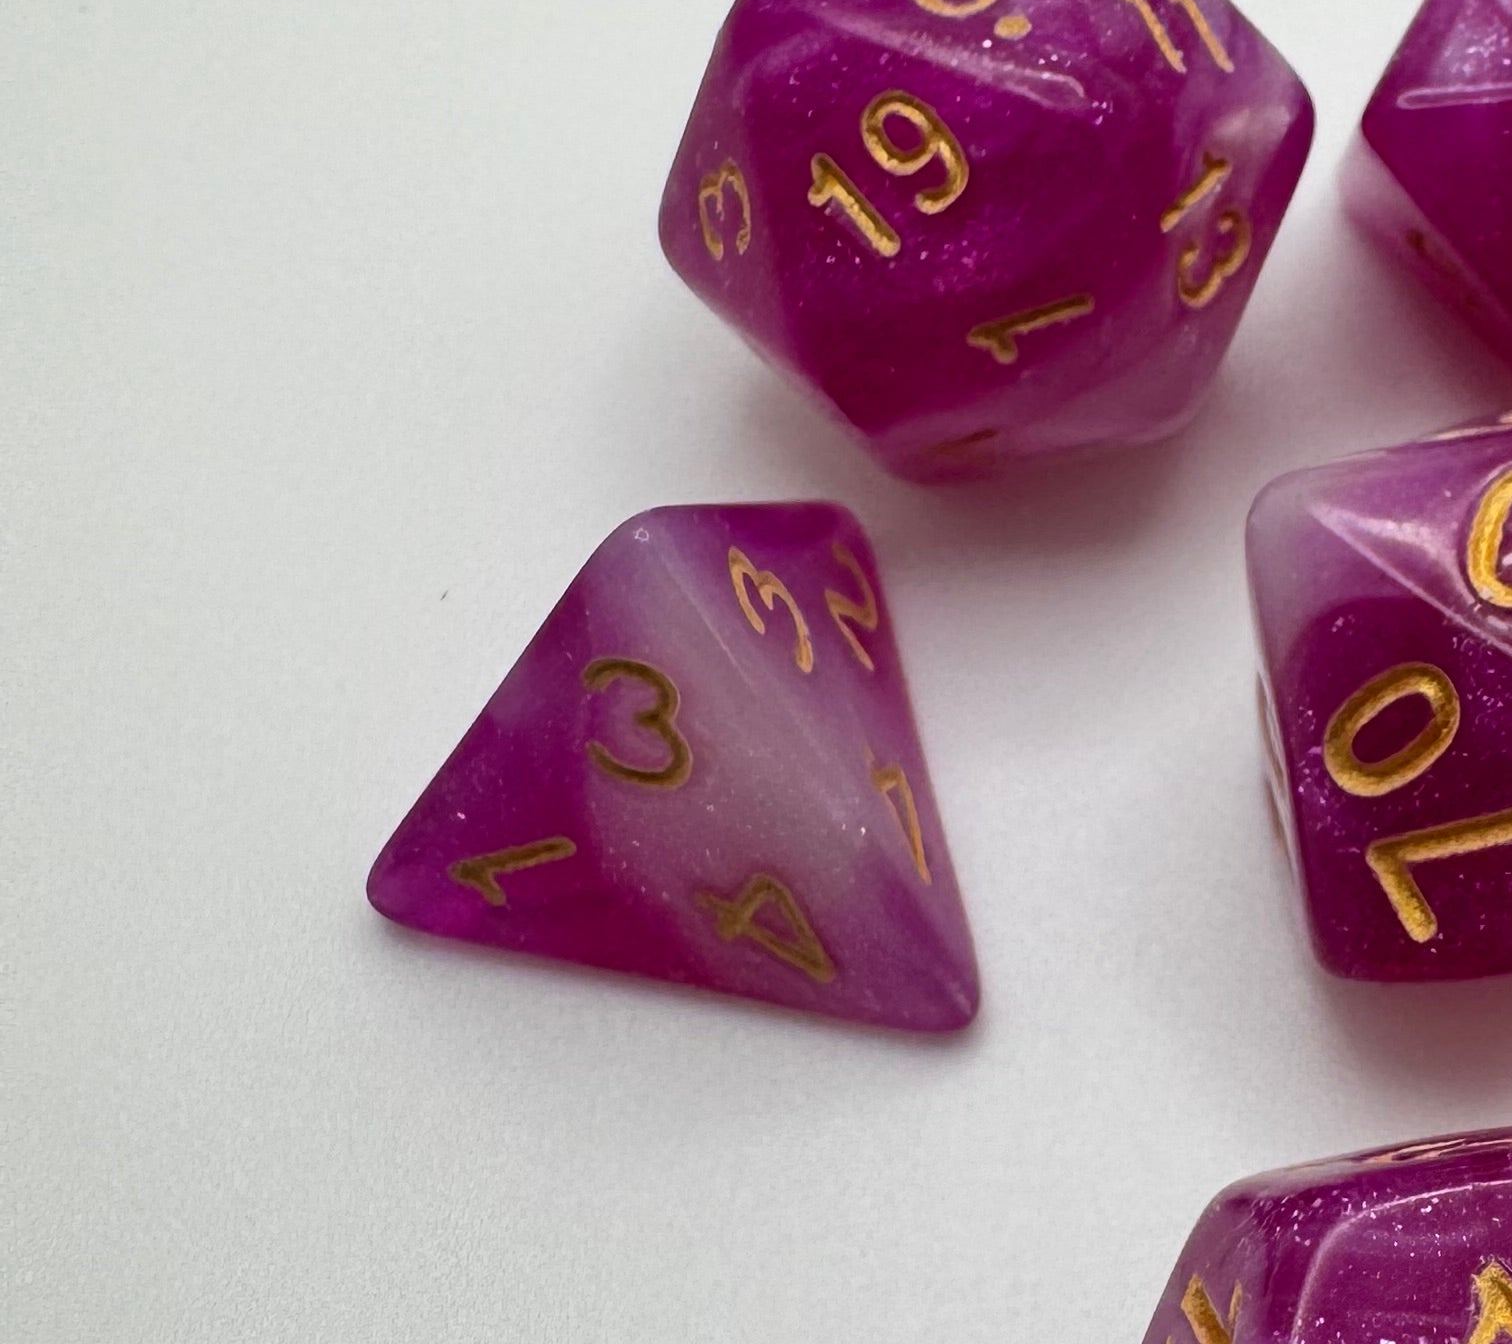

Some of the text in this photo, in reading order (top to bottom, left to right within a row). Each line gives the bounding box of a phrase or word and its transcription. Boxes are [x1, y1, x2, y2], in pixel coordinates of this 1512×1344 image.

[808, 89, 970, 259] 19
[1159, 152, 1252, 309] 13
[965, 294, 1096, 365] 1
[728, 545, 814, 674] 3
[582, 657, 693, 792] 3
[447, 835, 577, 909] 1
[695, 873, 838, 985] 4
